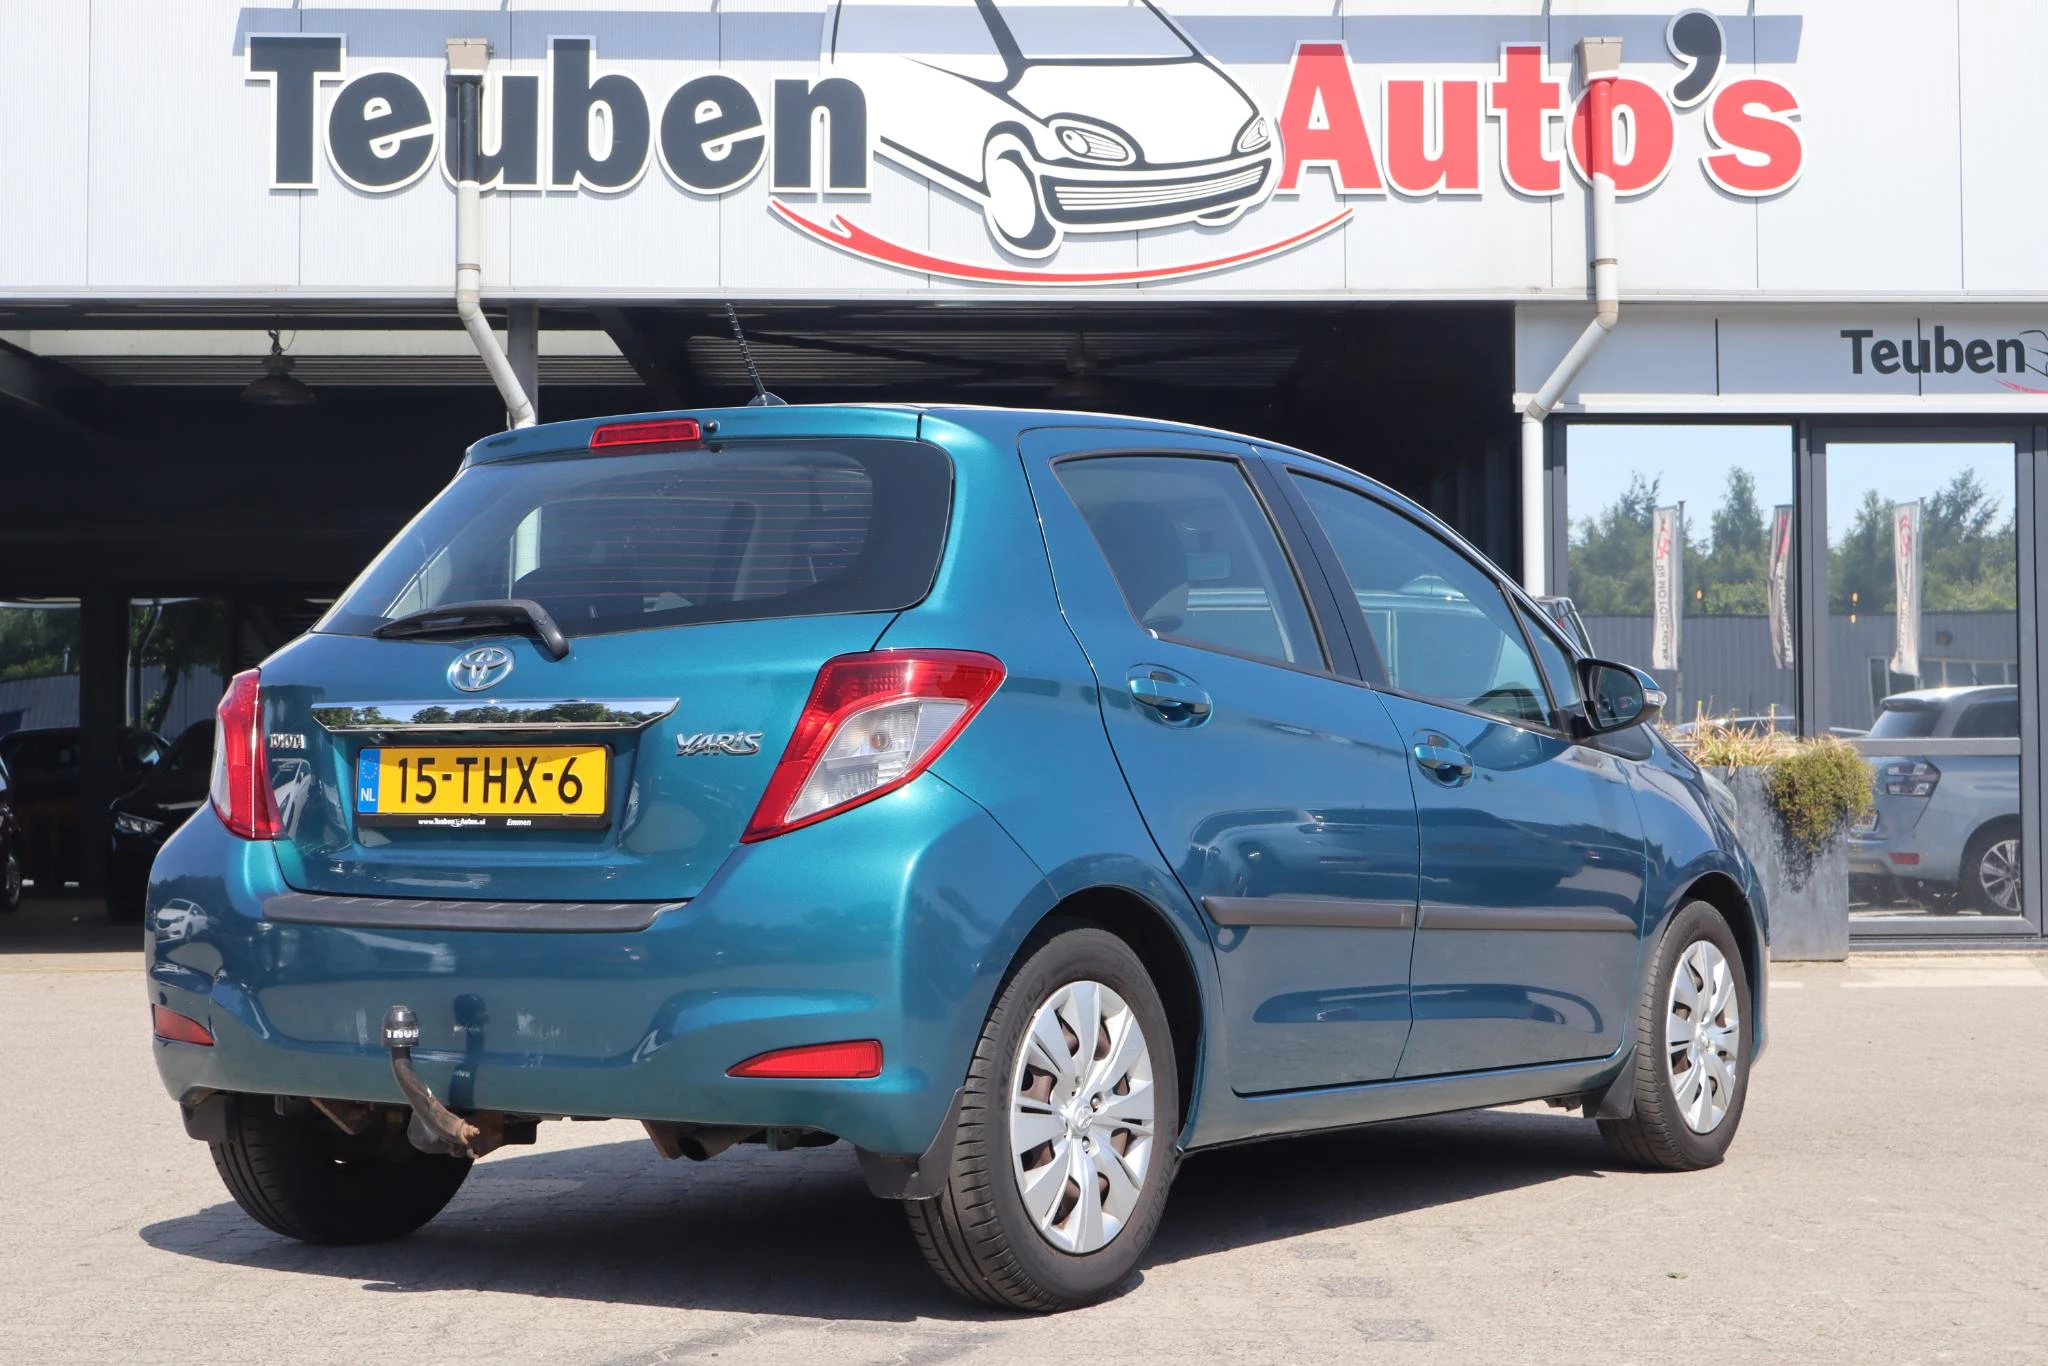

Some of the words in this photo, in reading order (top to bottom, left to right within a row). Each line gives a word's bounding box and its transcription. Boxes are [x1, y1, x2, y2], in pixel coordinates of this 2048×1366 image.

[249, 36, 868, 190] Teuben
[1277, 11, 1804, 192] Auto's
[1840, 325, 2026, 375] Teuben
[360, 787, 376, 802] NL
[398, 756, 583, 804] 15-THX-6
[506, 818, 532, 826] Emmen
